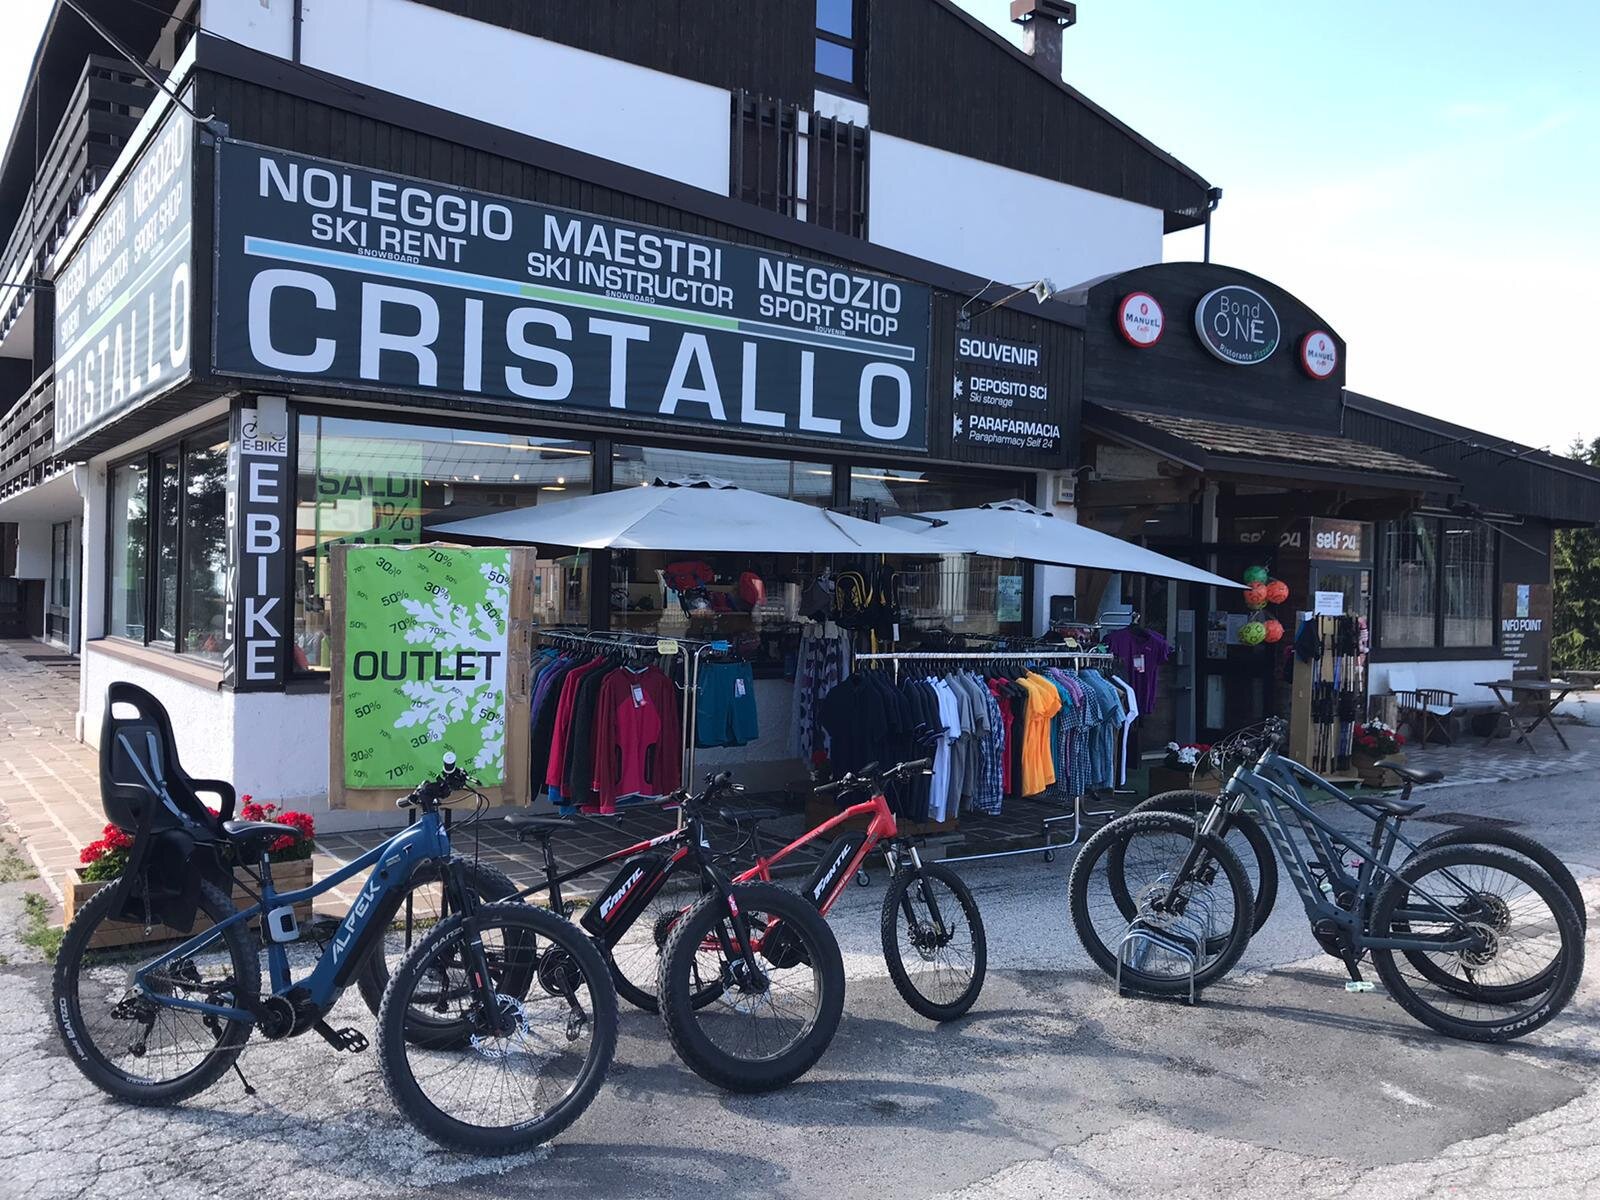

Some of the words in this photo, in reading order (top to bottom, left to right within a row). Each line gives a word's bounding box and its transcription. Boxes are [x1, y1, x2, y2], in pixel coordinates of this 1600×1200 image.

[259, 157, 513, 241] NOLEGGIO
[543, 214, 721, 281] MAESTRI
[758, 257, 901, 314] NEGOZIO
[312, 213, 367, 247] SKI
[380, 225, 467, 262] RENT
[357, 247, 420, 264] SNOWBOARD
[527, 252, 571, 282] SKI
[579, 264, 734, 309] INSTRUCTOR
[605, 289, 656, 304] SNOWBOARD
[1220, 295, 1260, 318] Bond
[760, 295, 834, 327] SPORT
[840, 310, 899, 337] SHOP
[1125, 313, 1160, 327] MANUEL
[1214, 311, 1265, 344] ONE
[55, 262, 189, 444] CRISTALLO
[248, 268, 911, 440] CRISTALLO
[960, 338, 1038, 367] SOUVENIR
[970, 377, 1027, 397] DEPOSITO
[1029, 385, 1047, 400] SCI
[969, 392, 982, 402] Ski
[983, 395, 1013, 408] storage
[969, 415, 1060, 438] PARAFARMACIA
[242, 440, 286, 453] E-BIKE
[969, 430, 1025, 448] Parapharmacy
[1026, 437, 1042, 448] Self
[1042, 439, 1053, 448] 24
[318, 467, 418, 498] SALDI
[1316, 531, 1341, 549] self
[1342, 534, 1356, 550] 24
[376, 557, 402, 578] 30%
[428, 549, 453, 568] 70%
[381, 589, 410, 607] 50%
[424, 582, 449, 600] 30%
[389, 617, 418, 633] 70%
[482, 602, 501, 628] 50%
[1502, 619, 1519, 632] INFO
[1520, 619, 1542, 632] POINT
[353, 650, 501, 682] OUTLET
[354, 701, 382, 718] 50%
[479, 708, 504, 726] 50%
[410, 730, 438, 748] 30%
[350, 747, 374, 762] 30%
[385, 762, 414, 780] 70%
[813, 843, 851, 900] FANTIC
[600, 867, 644, 919] FANTIC
[331, 880, 381, 965] ALPEK
[1490, 1004, 1550, 1034] KENDA
